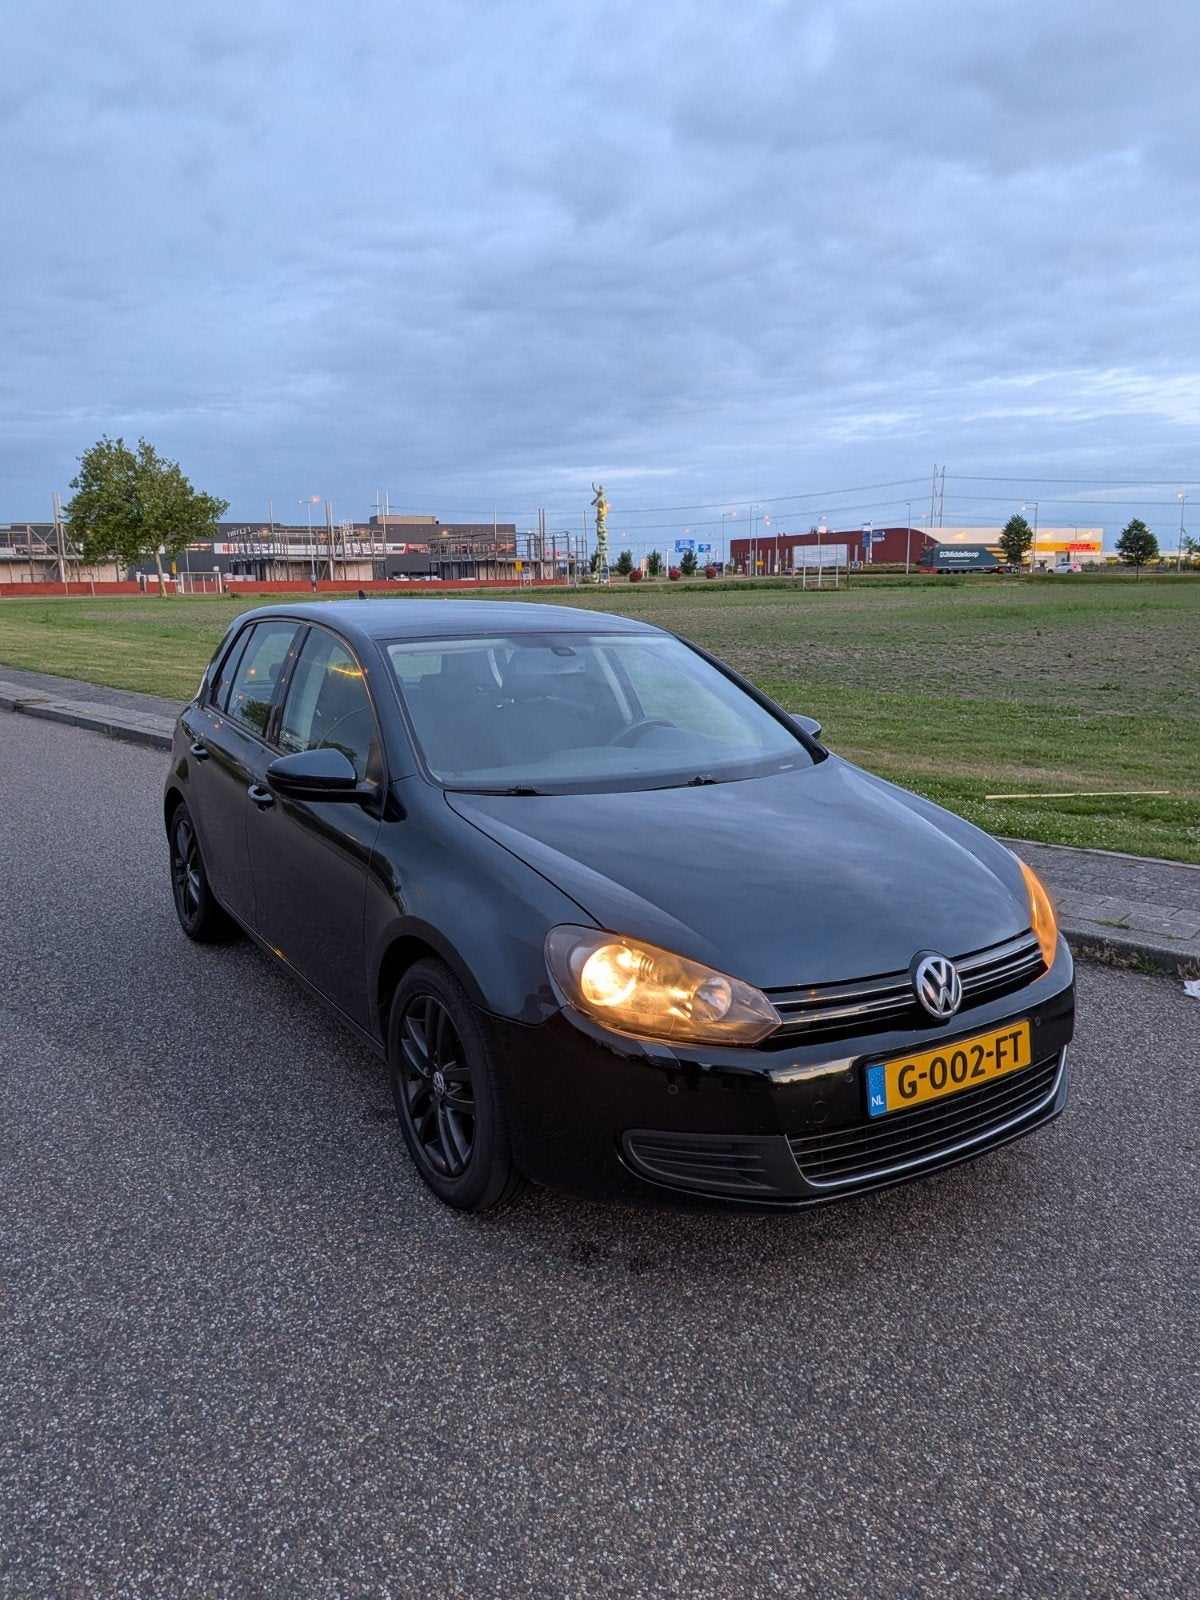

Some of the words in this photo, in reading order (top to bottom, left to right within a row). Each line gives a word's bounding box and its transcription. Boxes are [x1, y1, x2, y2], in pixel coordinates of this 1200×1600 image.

[917, 957, 962, 1017] VW
[898, 1030, 1023, 1099] G-002-FT
[871, 1095, 884, 1107] NL
